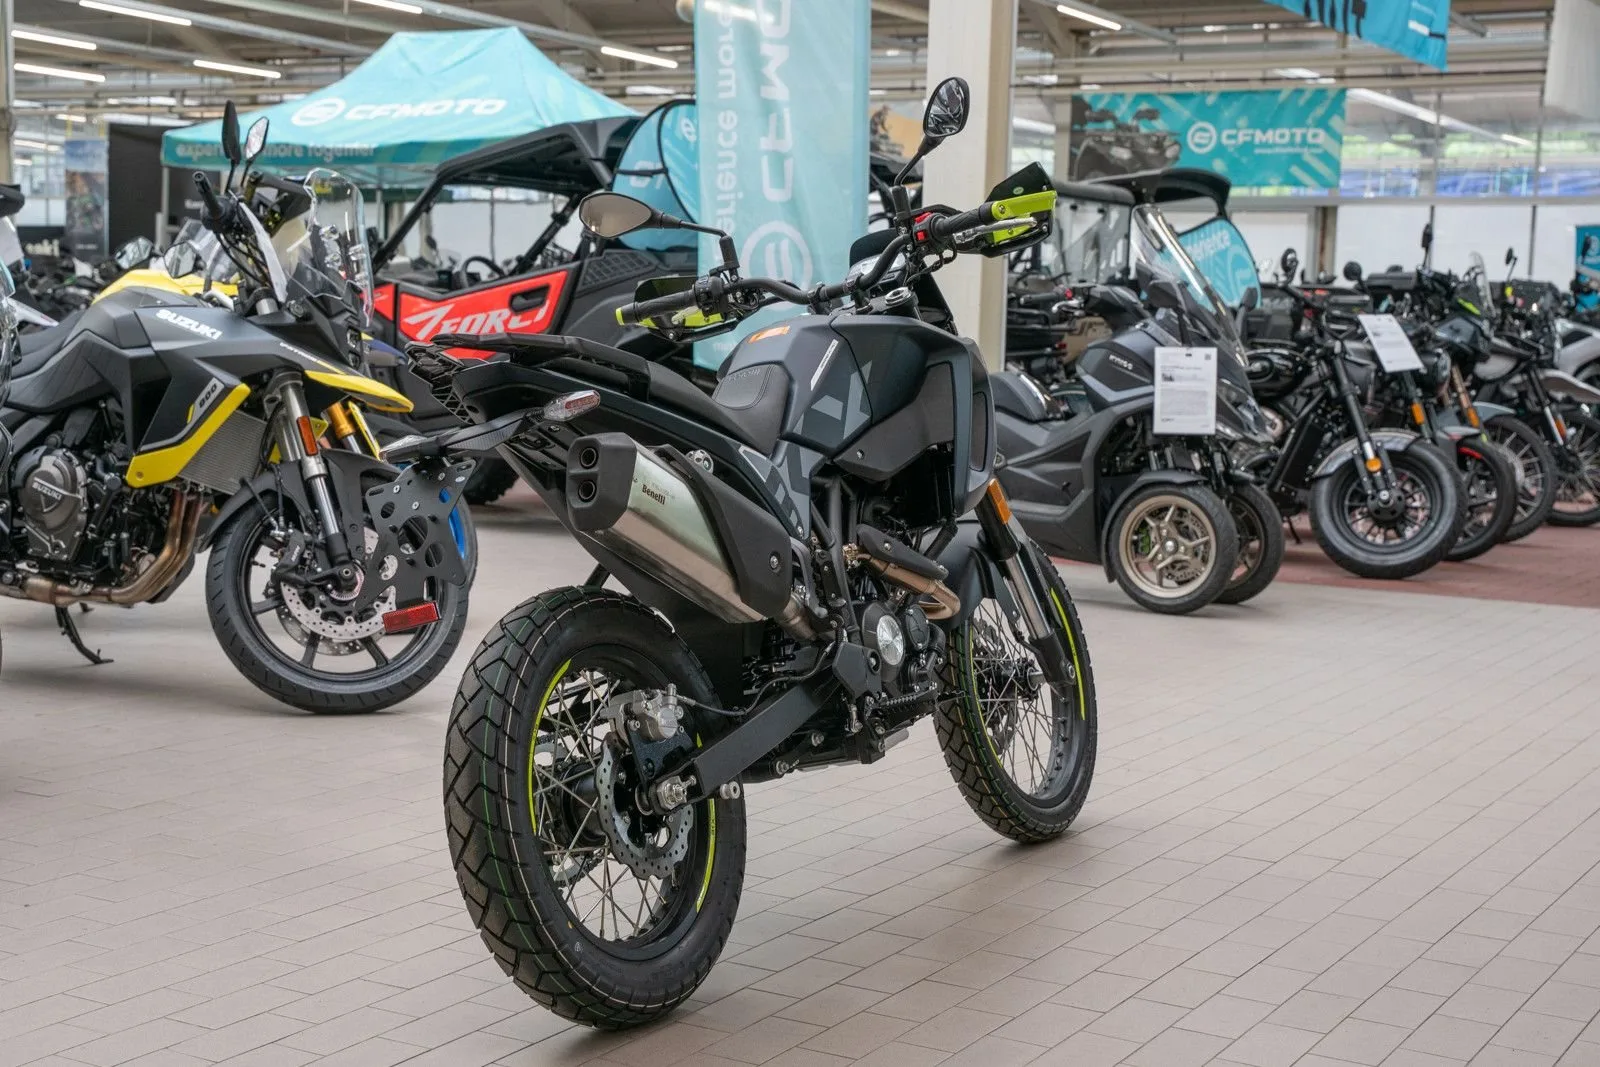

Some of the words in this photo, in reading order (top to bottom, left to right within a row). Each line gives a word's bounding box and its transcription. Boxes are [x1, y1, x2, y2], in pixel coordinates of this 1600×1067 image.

[344, 98, 507, 121] CFMOTO
[1220, 128, 1326, 145] CFMOTO
[155, 308, 224, 341] SUZUKI
[642, 483, 666, 506] Benelli
